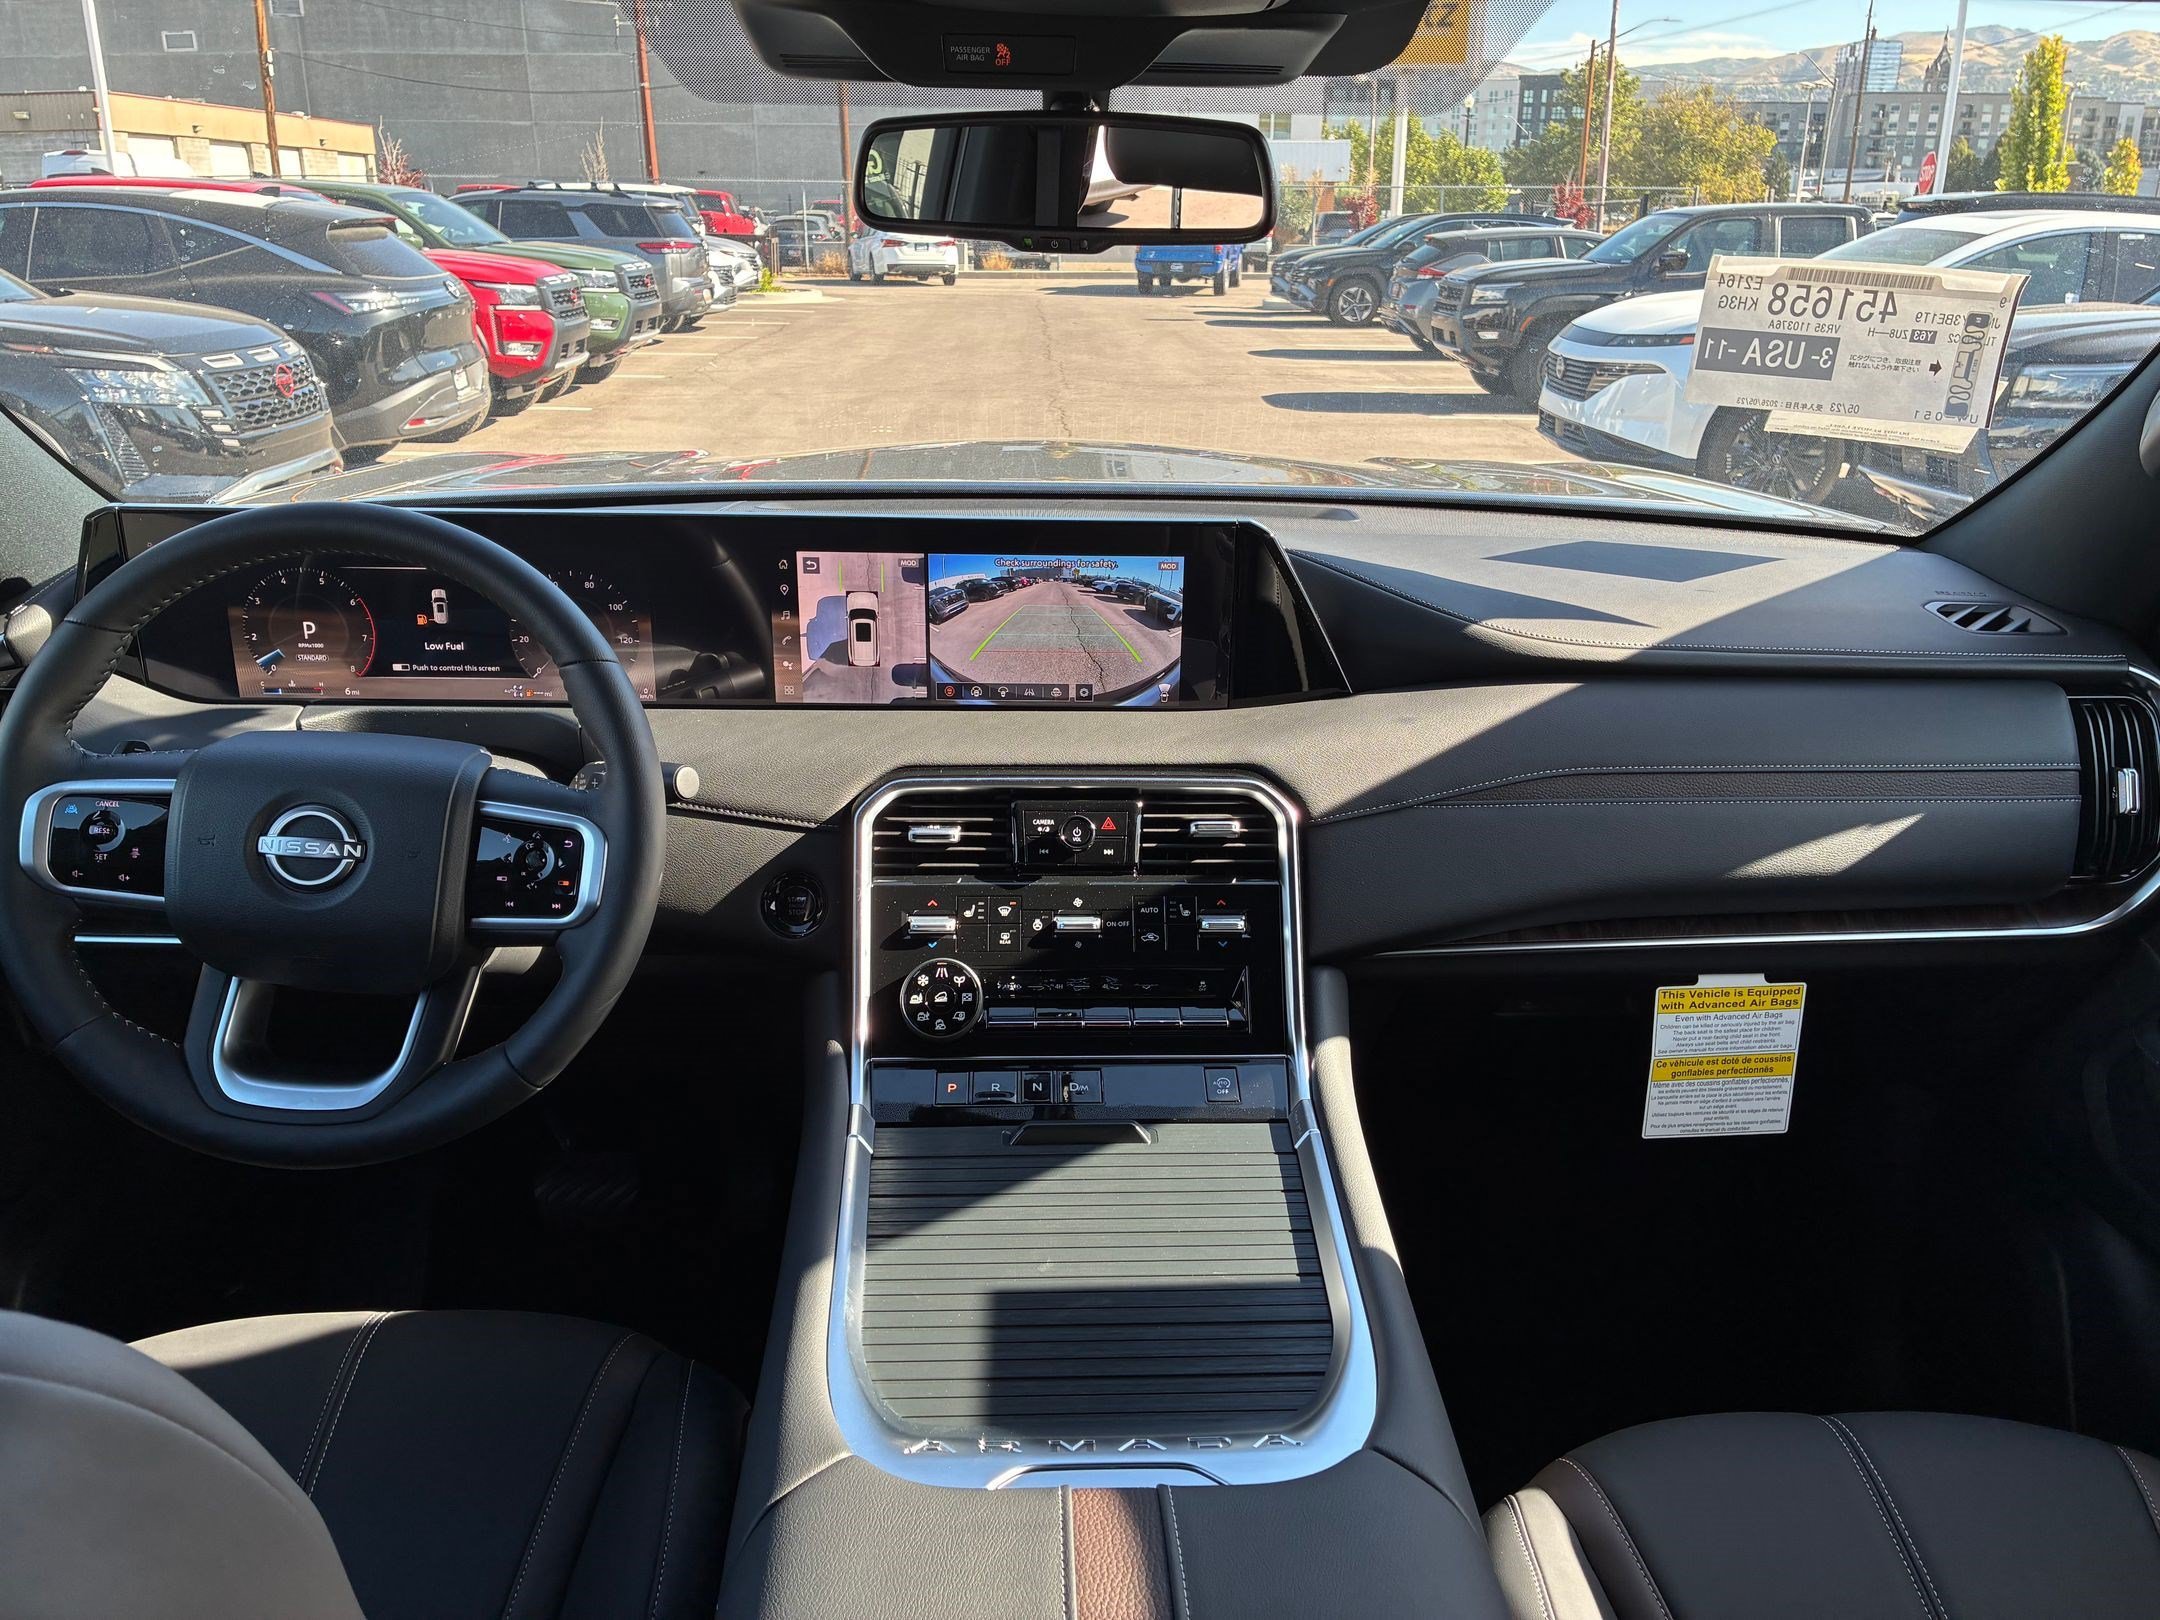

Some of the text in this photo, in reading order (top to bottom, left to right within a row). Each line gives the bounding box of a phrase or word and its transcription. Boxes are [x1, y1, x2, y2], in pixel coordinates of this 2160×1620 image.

[950, 46, 991, 54] PASSENGER
[1919, 164, 1935, 182] STOP
[994, 558, 1020, 568] Check
[1020, 559, 1075, 569] surroundings
[1076, 559, 1089, 568] for
[280, 577, 286, 585] 4
[319, 577, 325, 585] 5
[584, 581, 594, 589] 80
[608, 603, 623, 611] 100
[302, 621, 316, 640] P
[251, 633, 257, 641] 2
[362, 634, 367, 642] 7
[424, 642, 464, 651] Low Fuel
[345, 687, 351, 696] 6
[95, 800, 119, 808] CANCEL
[260, 838, 362, 858] NISSAN
[1661, 987, 1800, 999] This Vehicle is Equipped
[1661, 997, 1799, 1010] with Advanced Air Bags
[1675, 1014, 1695, 1023] Even
[1713, 1013, 1750, 1021] Advanced
[1764, 1011, 1783, 1020] Bags
[1656, 1060, 1667, 1068] Ce
[1754, 1055, 1792, 1064] coussins
[1671, 1068, 1714, 1079] gonflables
[1032, 1082, 1042, 1092] N
[1721, 1078, 1750, 1087] gonflables
[947, 1083, 957, 1093] P
[991, 1083, 1000, 1092] R
[903, 1432, 1305, 1455] ARMADA
